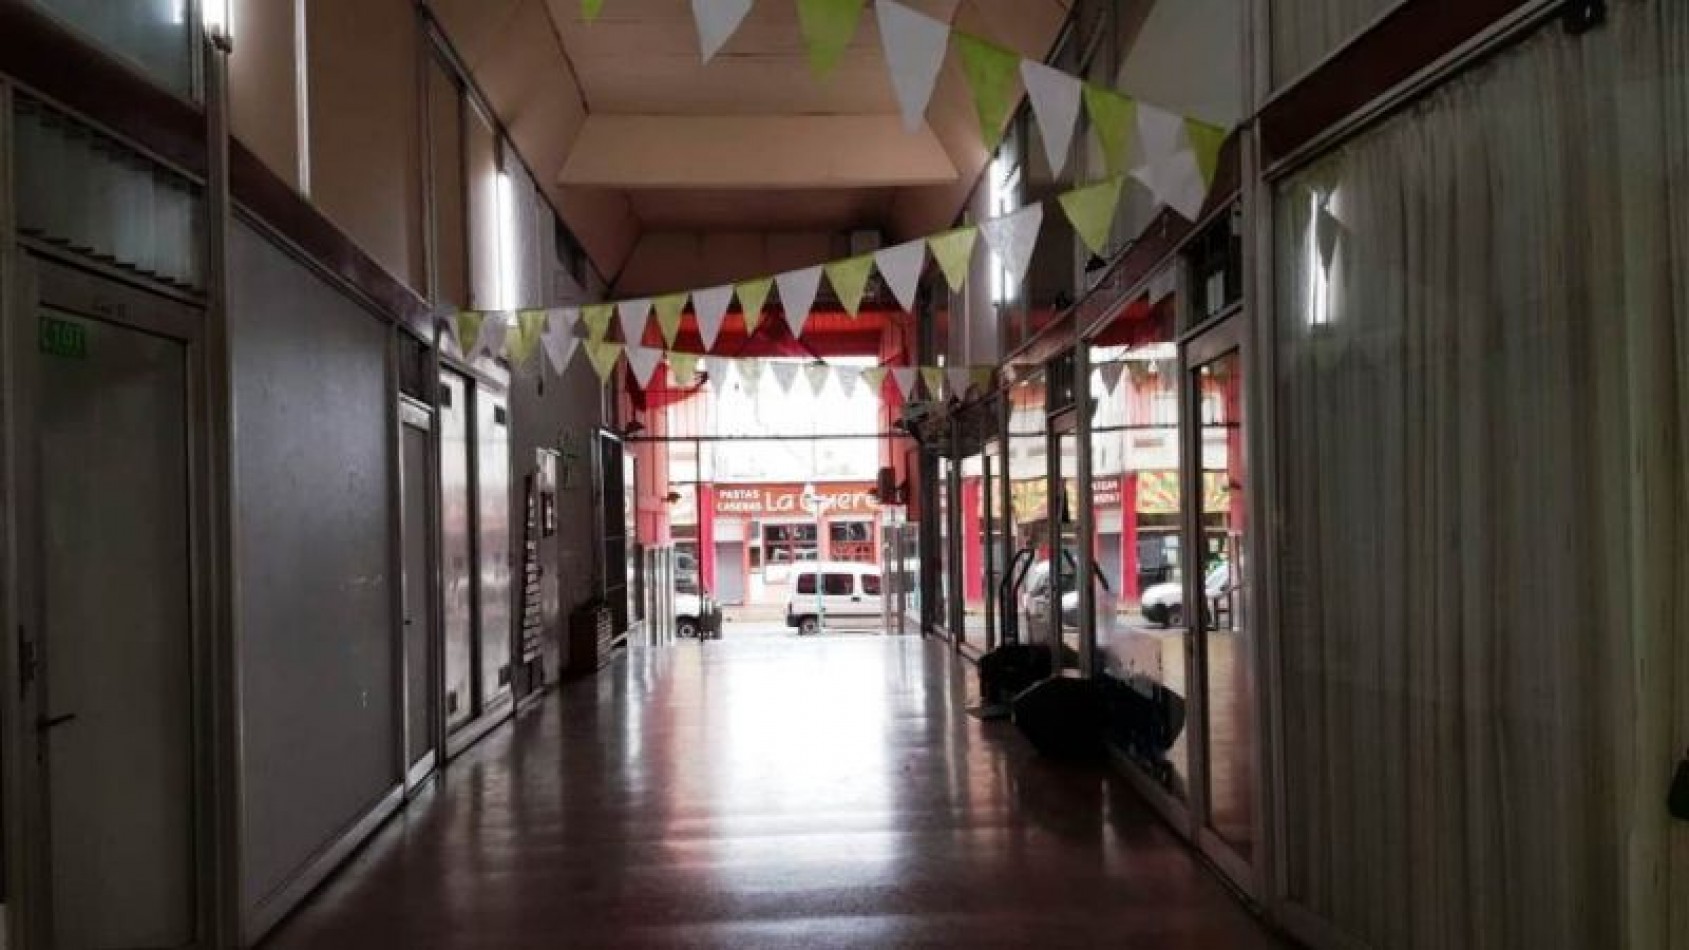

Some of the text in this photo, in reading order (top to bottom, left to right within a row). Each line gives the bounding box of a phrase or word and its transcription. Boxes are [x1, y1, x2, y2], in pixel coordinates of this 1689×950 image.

[719, 489, 760, 499] PASTAS
[717, 501, 761, 511] CASERAS
[766, 492, 793, 512] La
